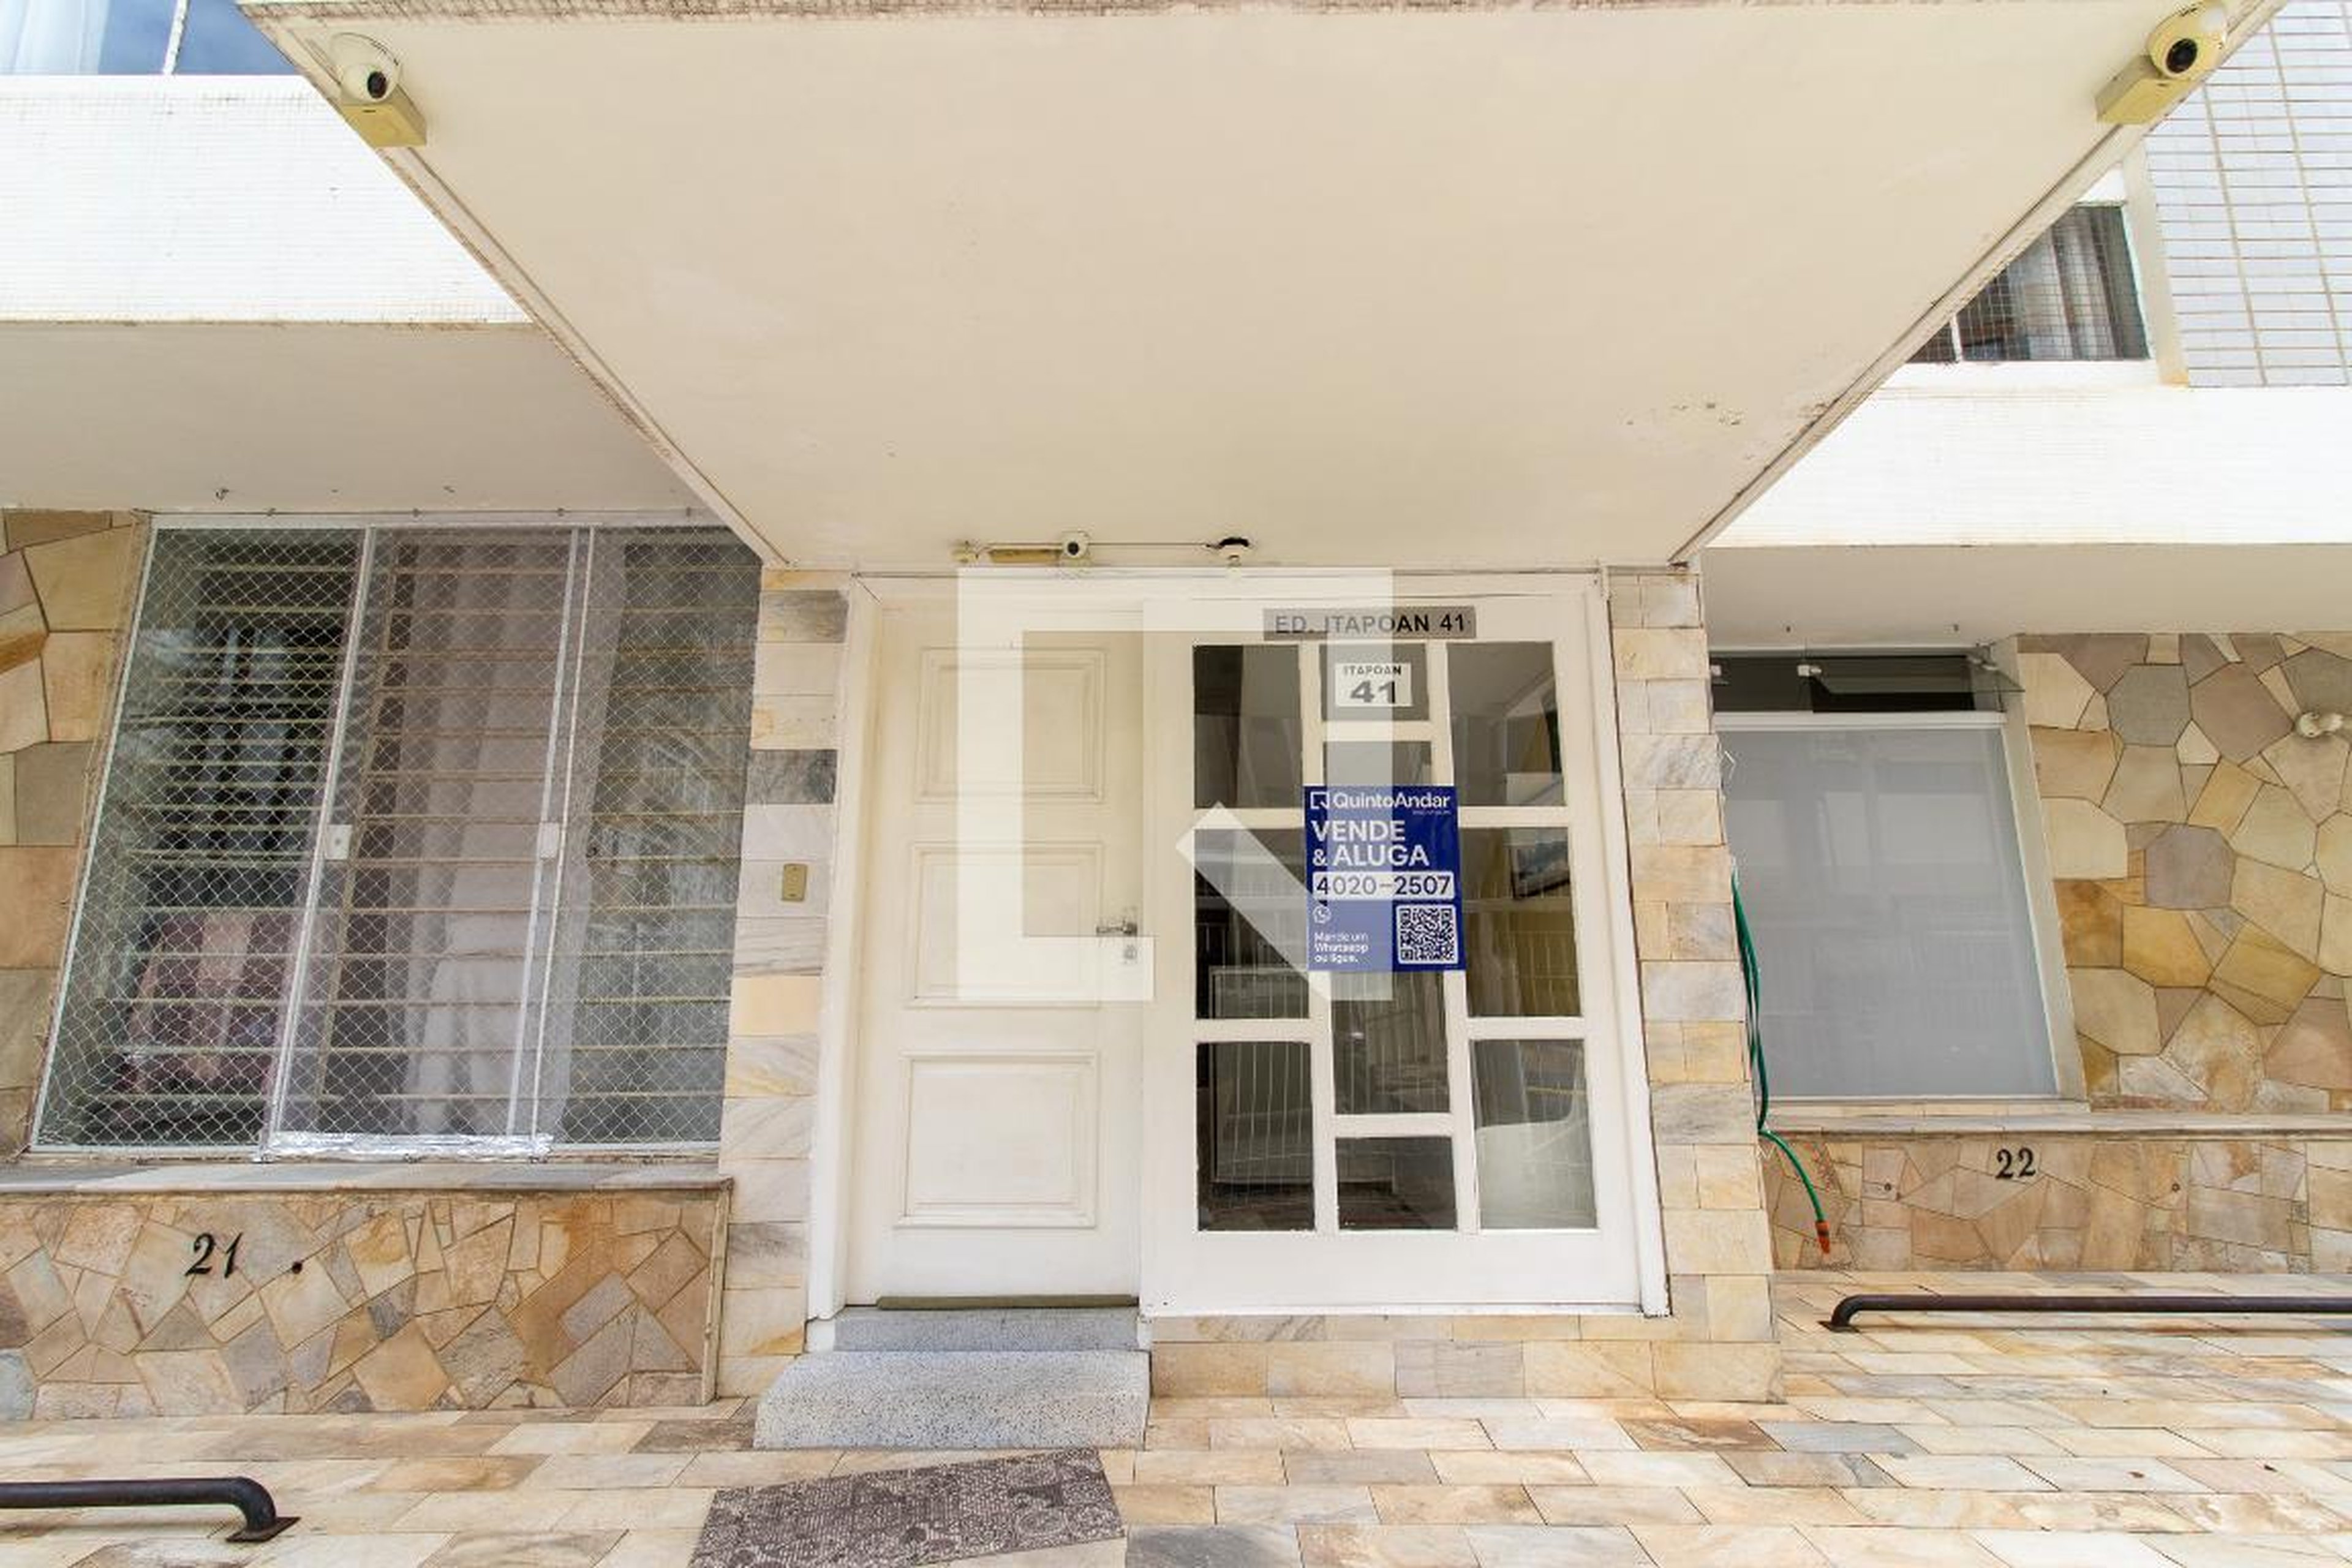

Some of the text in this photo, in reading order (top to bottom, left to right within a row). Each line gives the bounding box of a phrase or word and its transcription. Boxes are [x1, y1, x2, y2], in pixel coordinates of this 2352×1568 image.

[1275, 614, 1464, 633] ED. ITAPOAN 41
[1344, 665, 1401, 675] ITAPOAN
[1351, 680, 1396, 703] 41
[1332, 791, 1450, 809] QuintoAndar
[1311, 820, 1406, 842] VENDE
[1313, 845, 1430, 867] & ALUGA
[1316, 876, 1451, 895] 4020-2507
[1995, 1147, 2036, 1179] 22
[184, 1232, 243, 1278] 21
